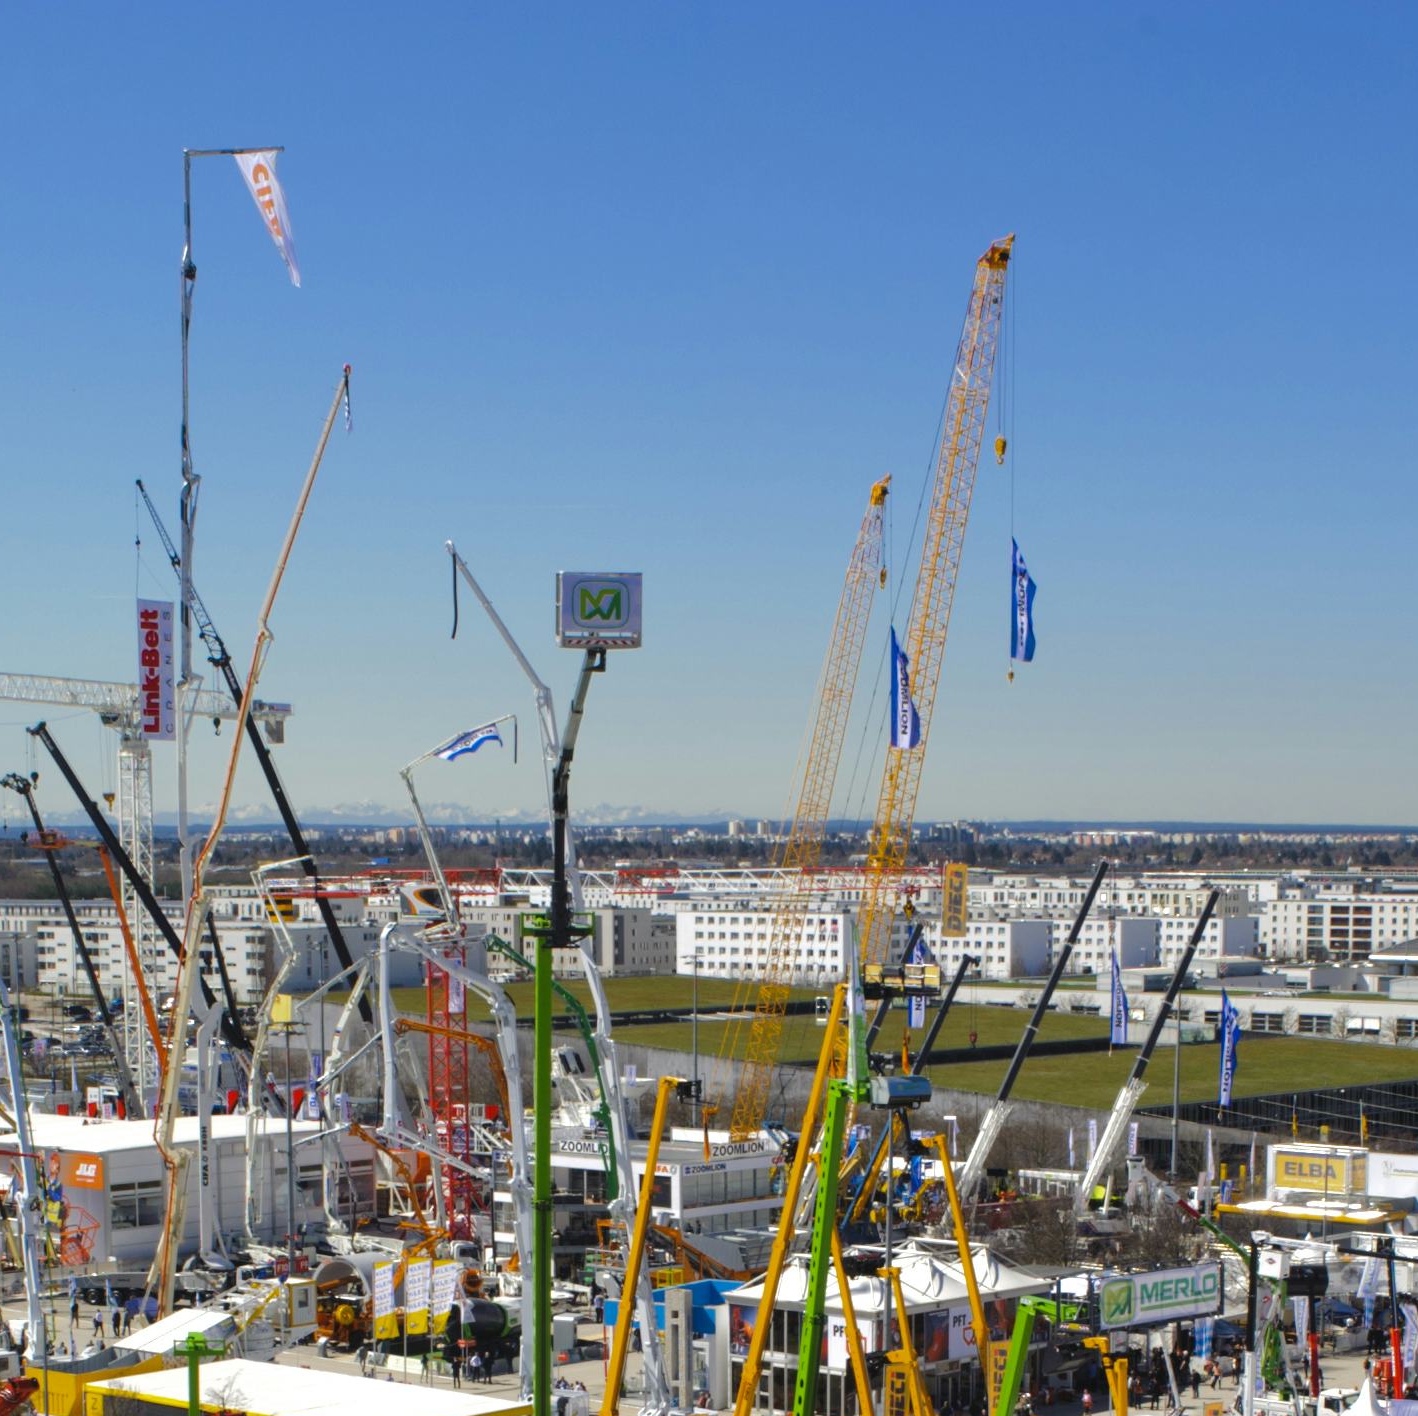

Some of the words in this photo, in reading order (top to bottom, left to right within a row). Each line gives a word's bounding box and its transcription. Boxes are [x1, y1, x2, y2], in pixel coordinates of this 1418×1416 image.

[139, 609, 161, 734] Link-Belt
[163, 611, 175, 734] CRANES
[561, 1141, 607, 1155] ZOOMLIO
[712, 1141, 766, 1156] ZOOMLION
[75, 1163, 97, 1177] JLG
[1284, 1161, 1337, 1179] ELBA
[1140, 1273, 1218, 1305] MERLO
[952, 1314, 968, 1328] PFT
[833, 1325, 846, 1338] PF
